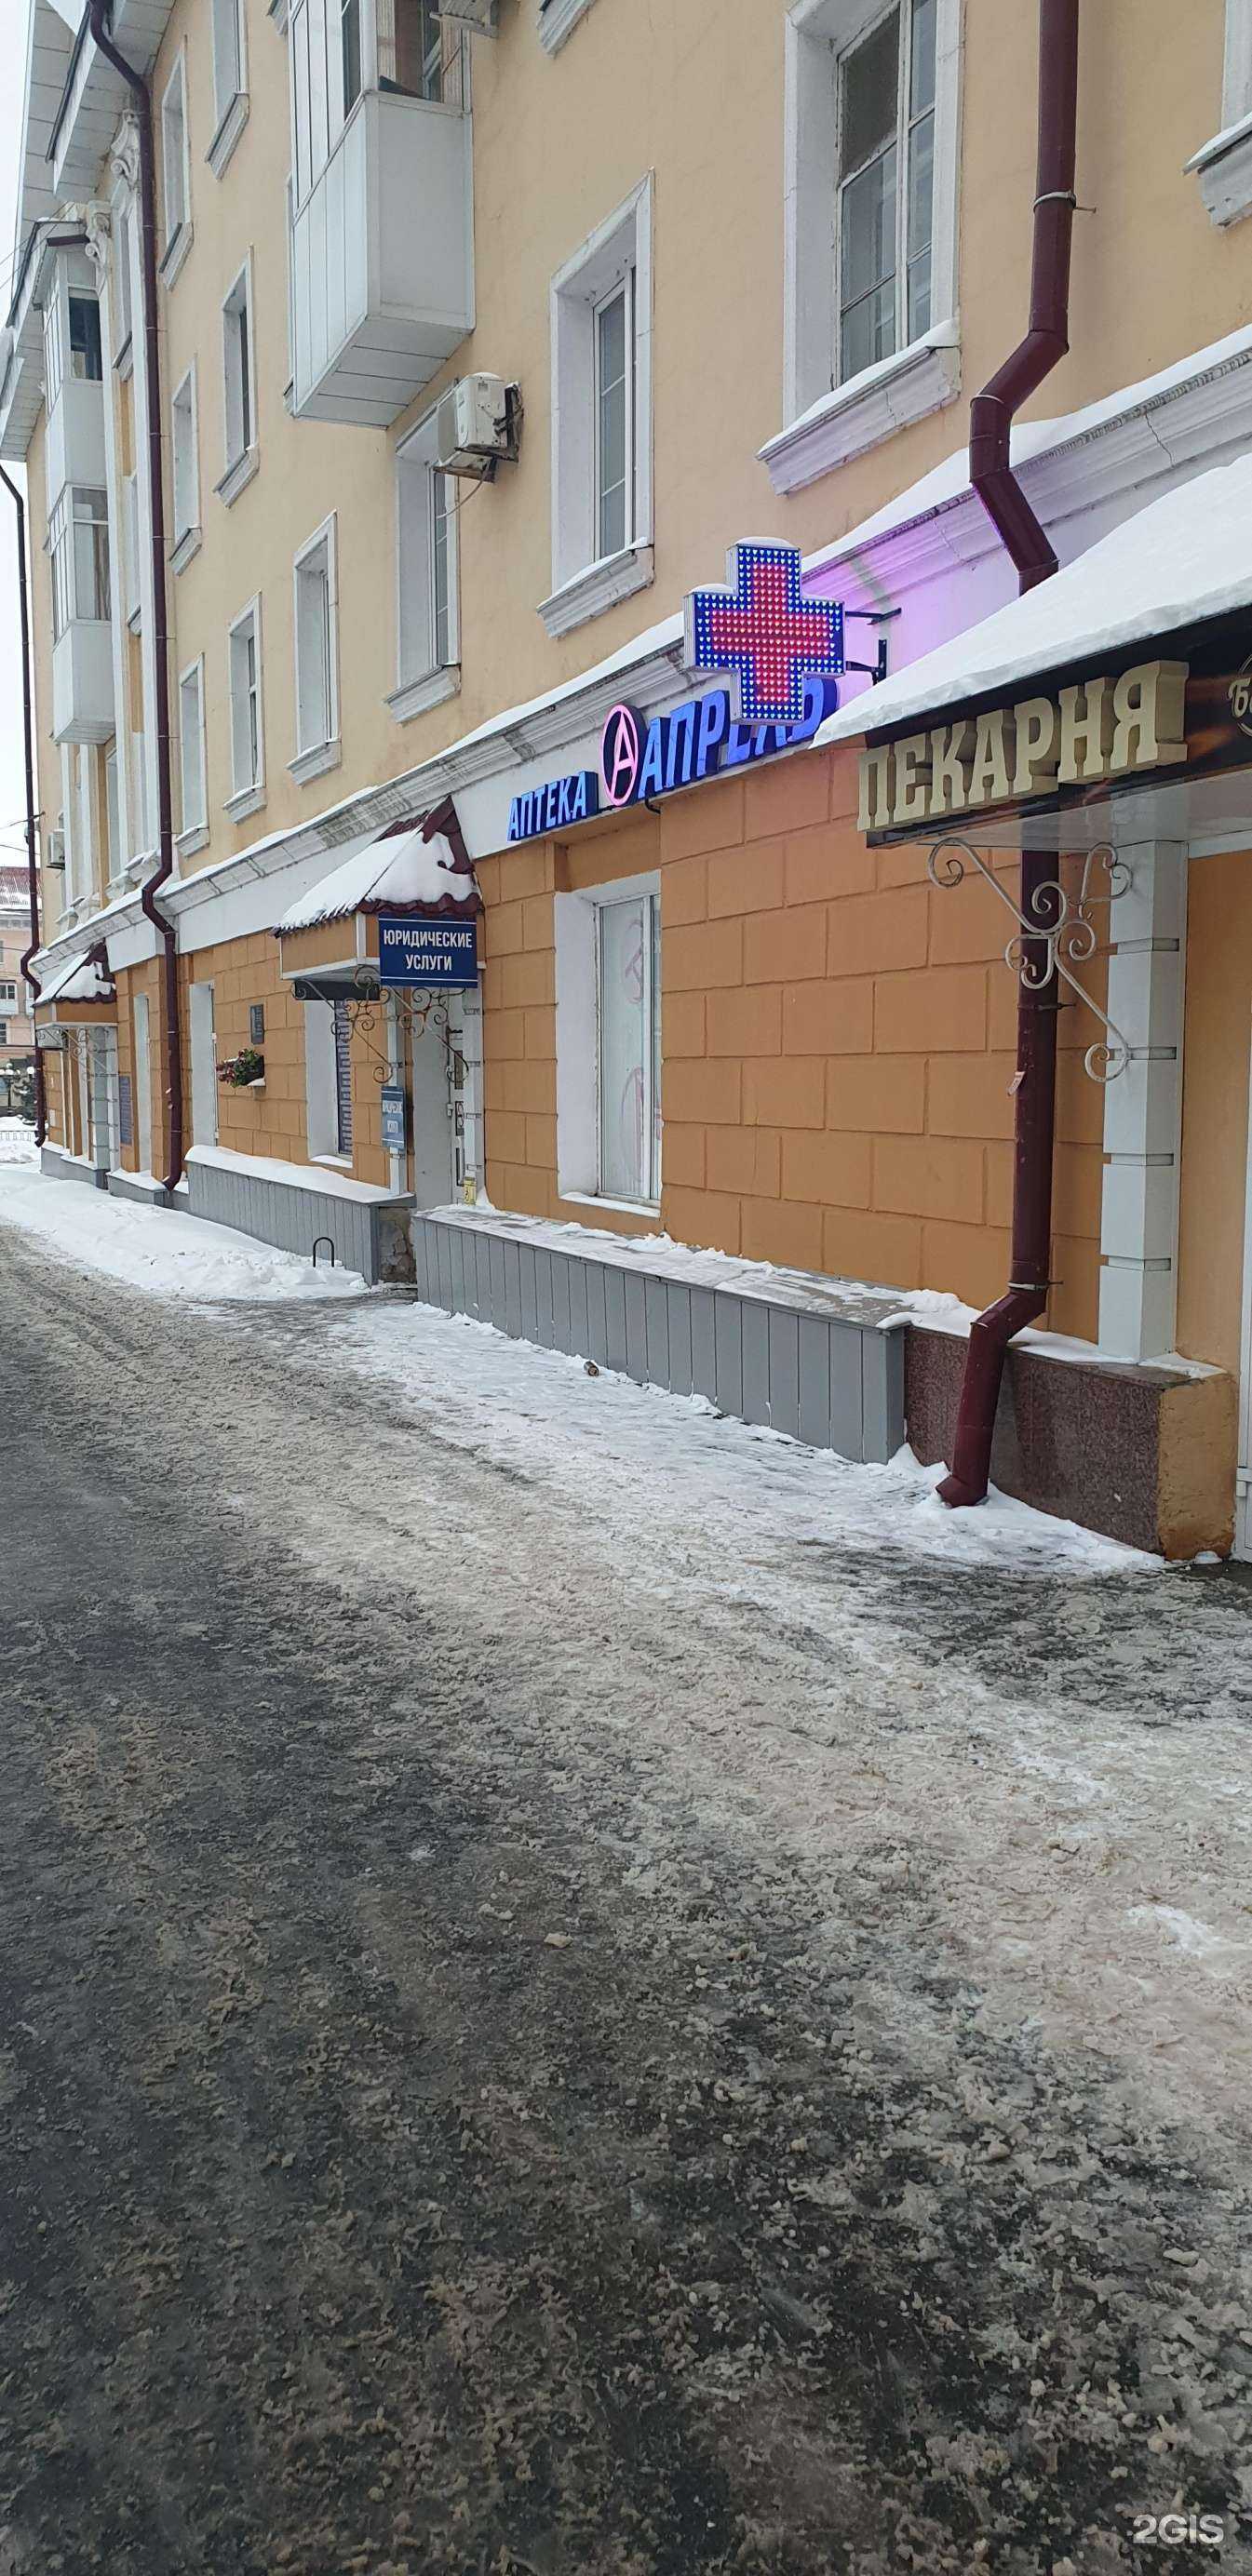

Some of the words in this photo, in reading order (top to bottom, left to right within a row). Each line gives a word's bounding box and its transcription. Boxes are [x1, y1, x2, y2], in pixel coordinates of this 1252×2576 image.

[857, 660, 1169, 832] ПЕКАРНЯ
[507, 771, 589, 841] АПТЕКА
[384, 929, 473, 948] ЮРИДИЧЕСКИЕ
[405, 954, 452, 971] УСЛУГИ
